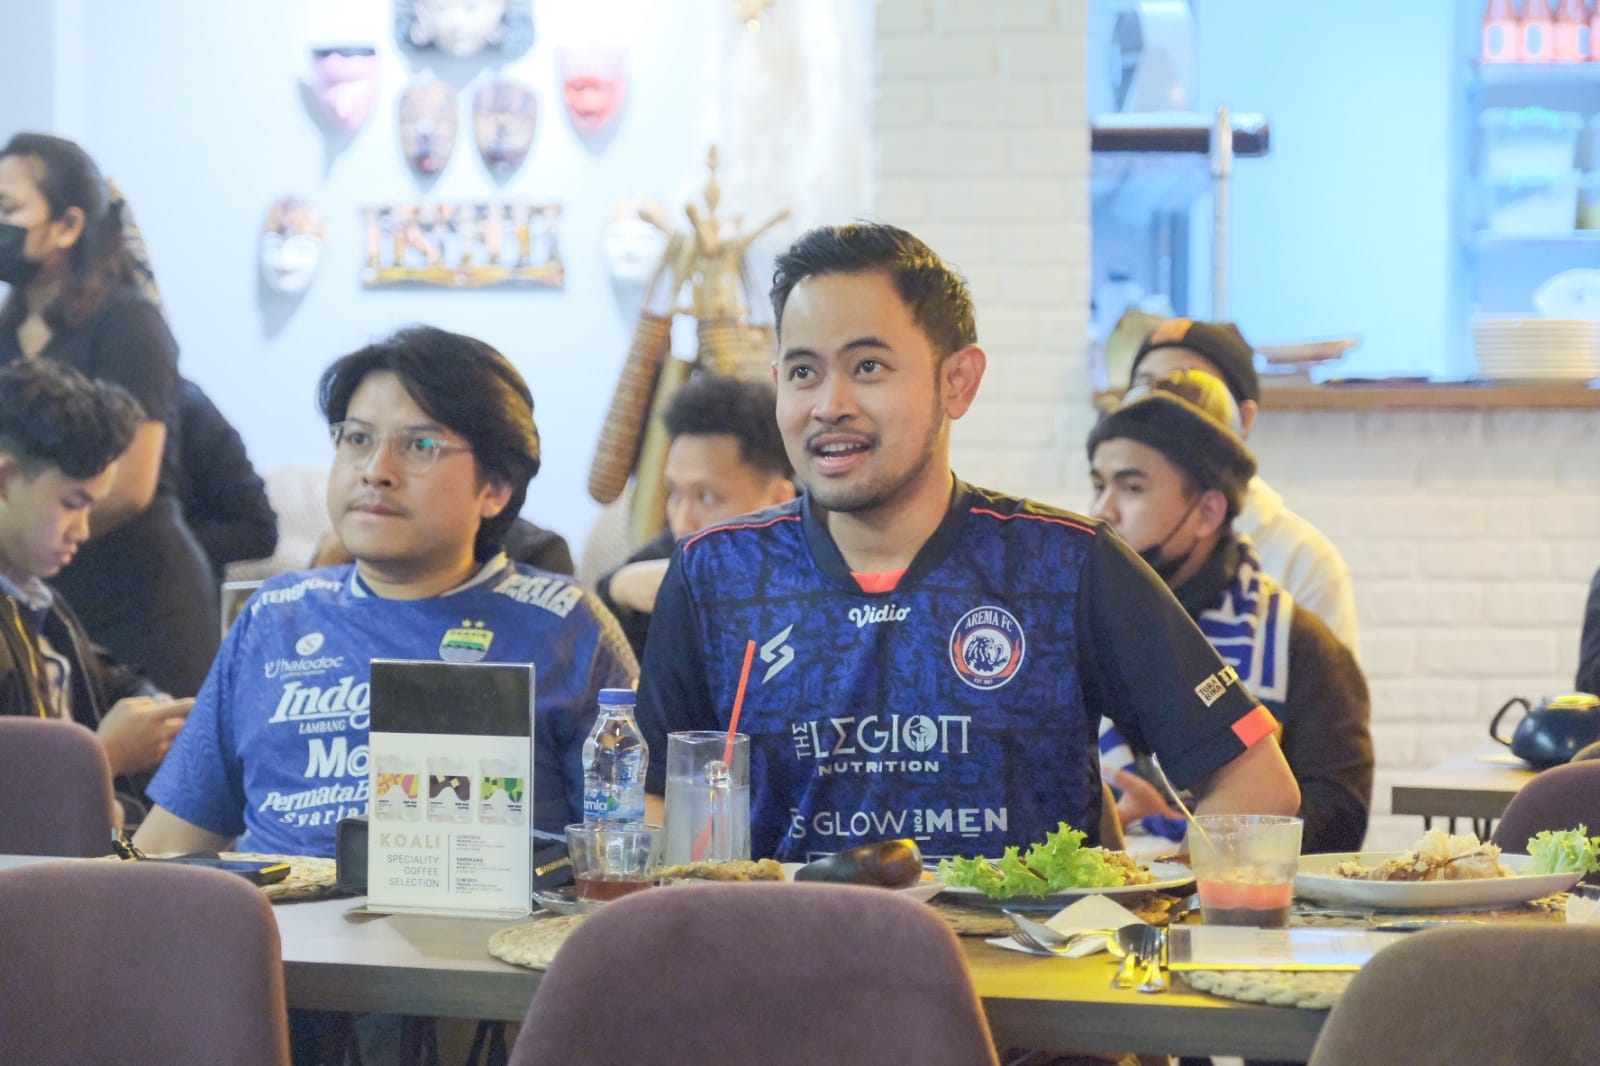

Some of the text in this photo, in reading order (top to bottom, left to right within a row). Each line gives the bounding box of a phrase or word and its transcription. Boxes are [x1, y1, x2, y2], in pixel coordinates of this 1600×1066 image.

[848, 603, 912, 628] Vidio
[964, 609, 1014, 633] AREMA FC
[818, 760, 940, 776] NUTRITION
[812, 809, 908, 837] GLOW
[913, 809, 923, 833] FOR
[925, 807, 1008, 834] MEN
[379, 833, 440, 849] KOALI
[386, 854, 439, 864] SPECIALITY
[403, 866, 439, 876] COFFEE
[389, 877, 439, 888] SELECTION
